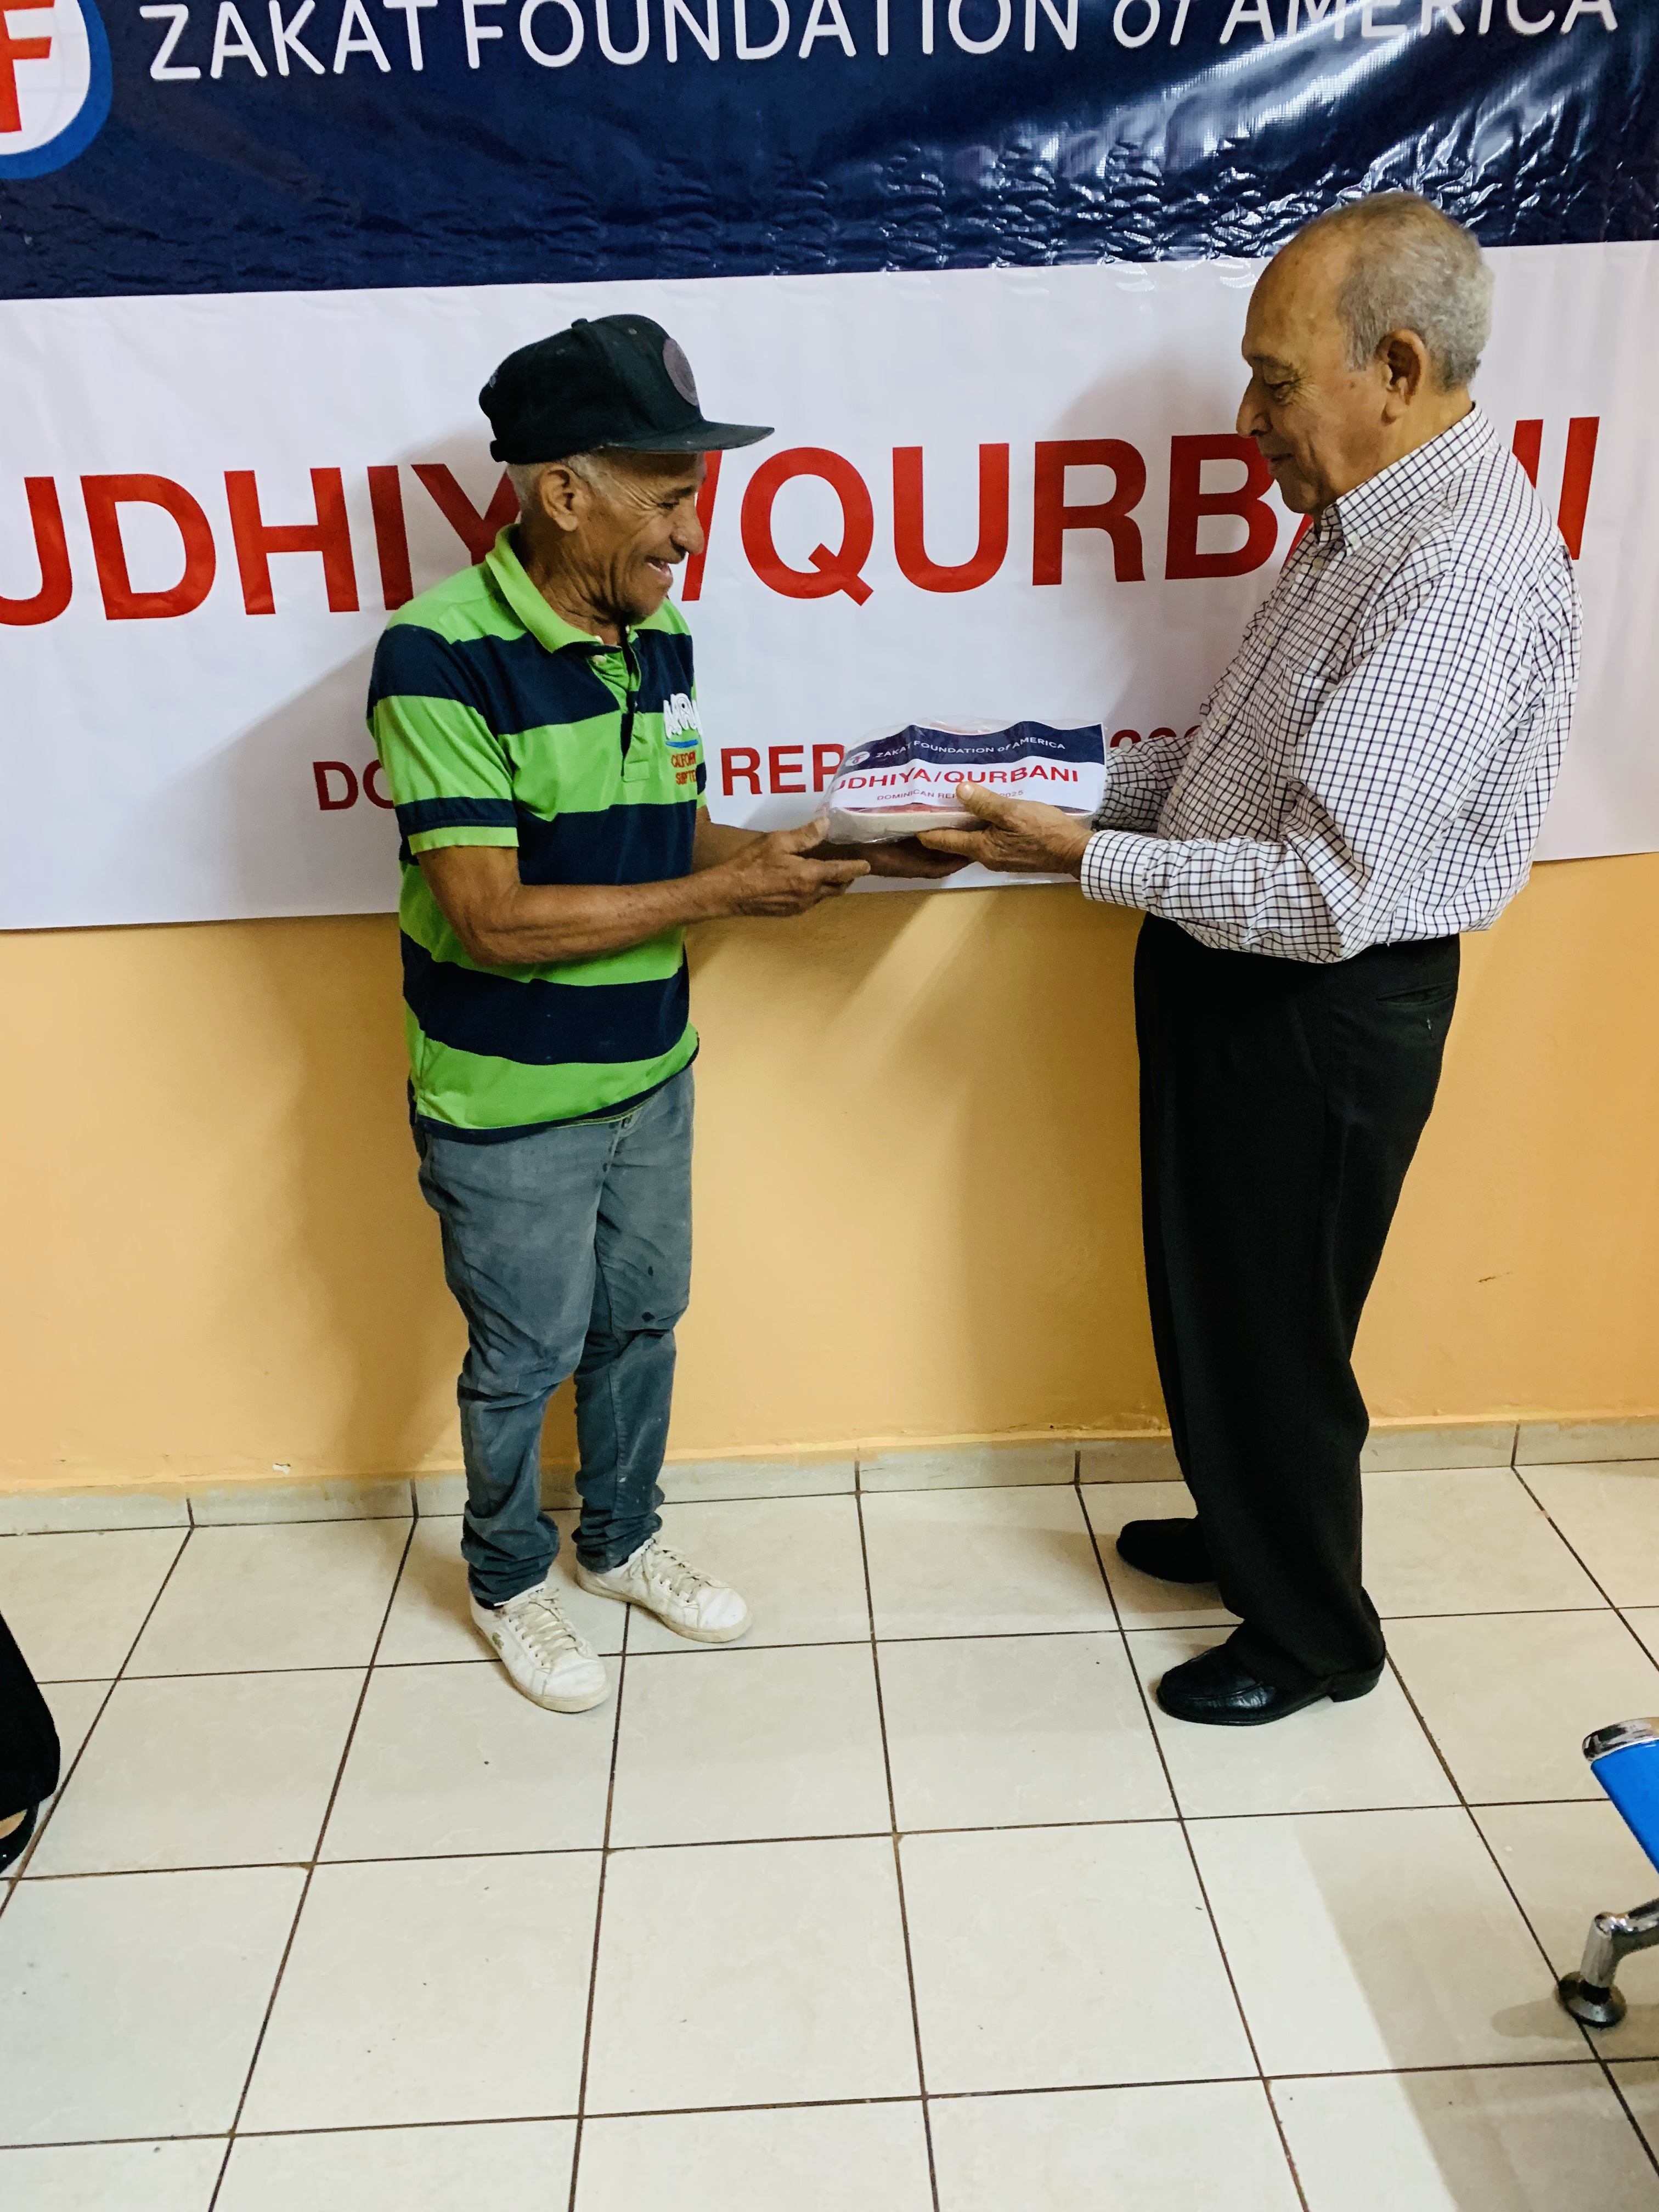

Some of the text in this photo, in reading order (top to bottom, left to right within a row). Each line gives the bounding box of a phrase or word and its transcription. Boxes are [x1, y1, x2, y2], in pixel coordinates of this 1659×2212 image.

[140, 0, 437, 80] ZAKAT
[875, 742, 912, 758] ZAKAT
[913, 740, 994, 754] FOUNDATION
[1012, 737, 1065, 749] AMERICA
[877, 789, 934, 801] DOMINICAN
